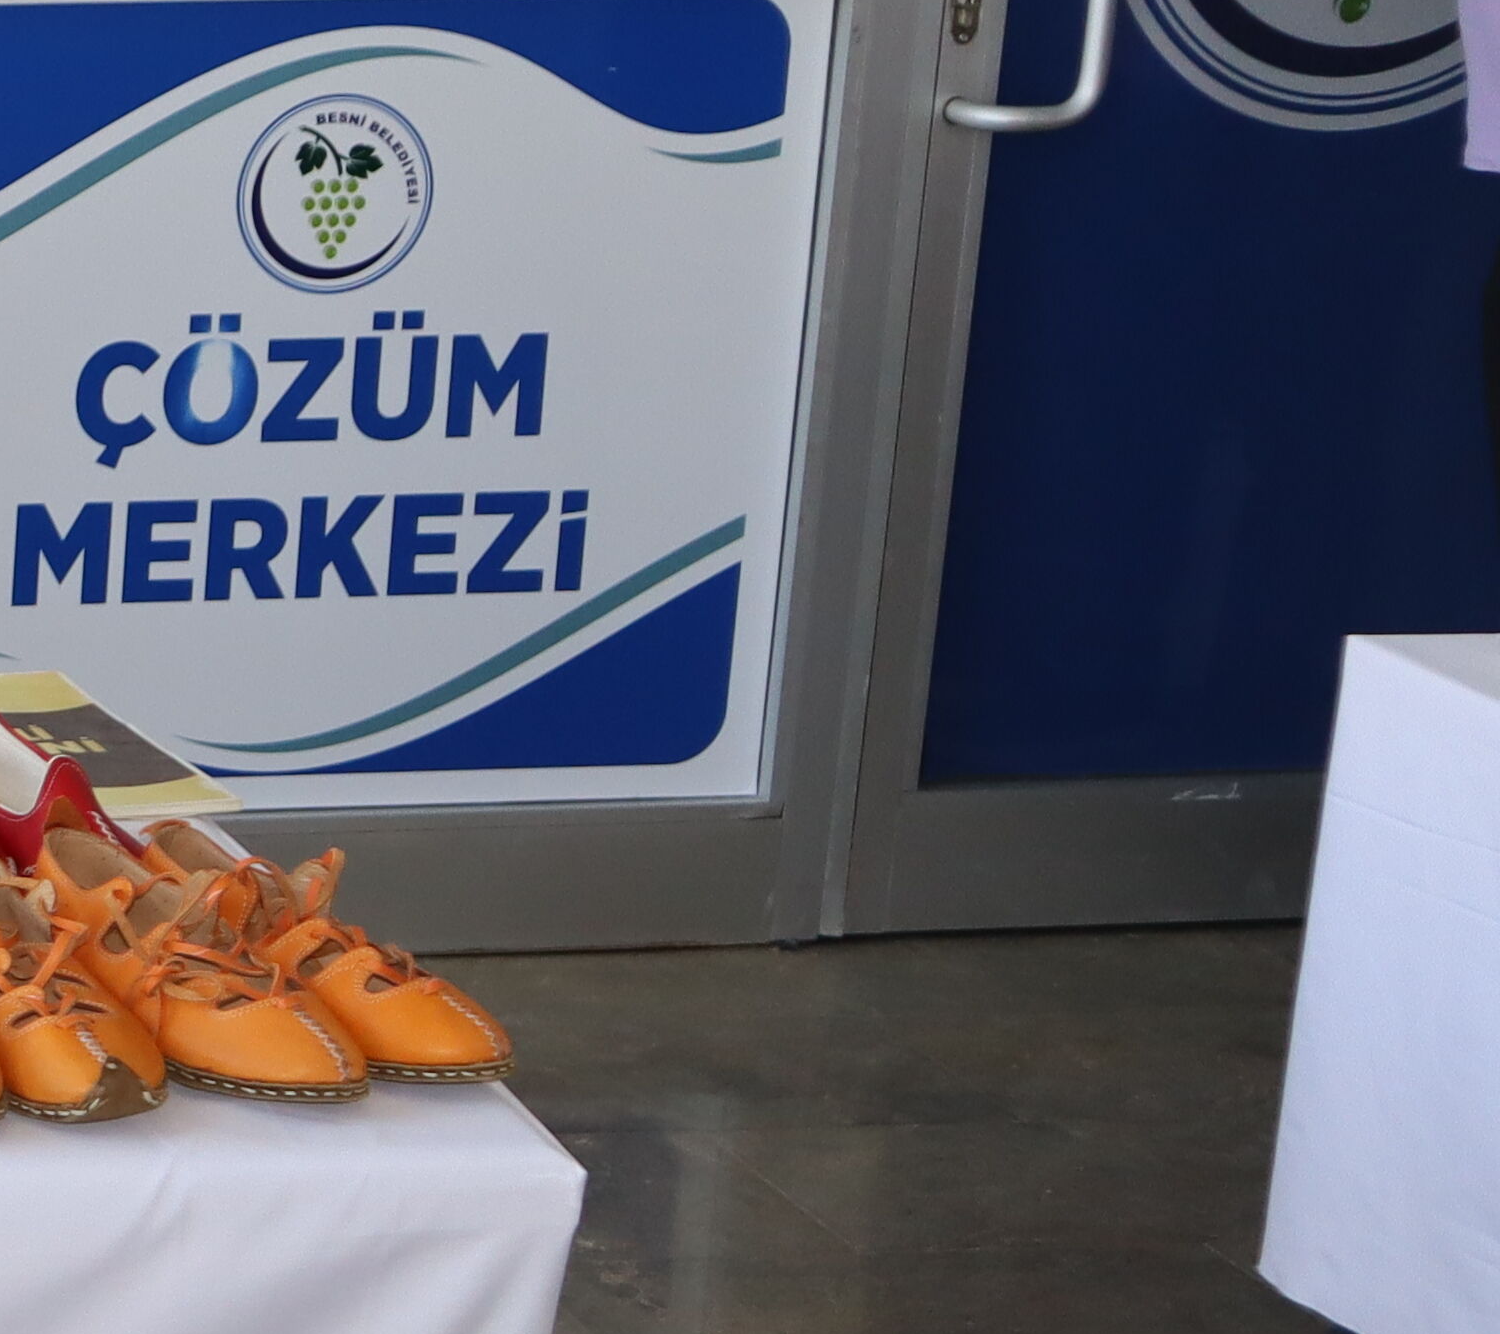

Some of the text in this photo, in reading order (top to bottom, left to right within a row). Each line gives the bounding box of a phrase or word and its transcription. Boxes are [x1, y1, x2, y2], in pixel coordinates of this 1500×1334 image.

[315, 111, 420, 204] BESNİ BELEDİYESİ
[75, 310, 549, 469] ÇÖZÜM
[11, 489, 590, 607] MERKEZİ
